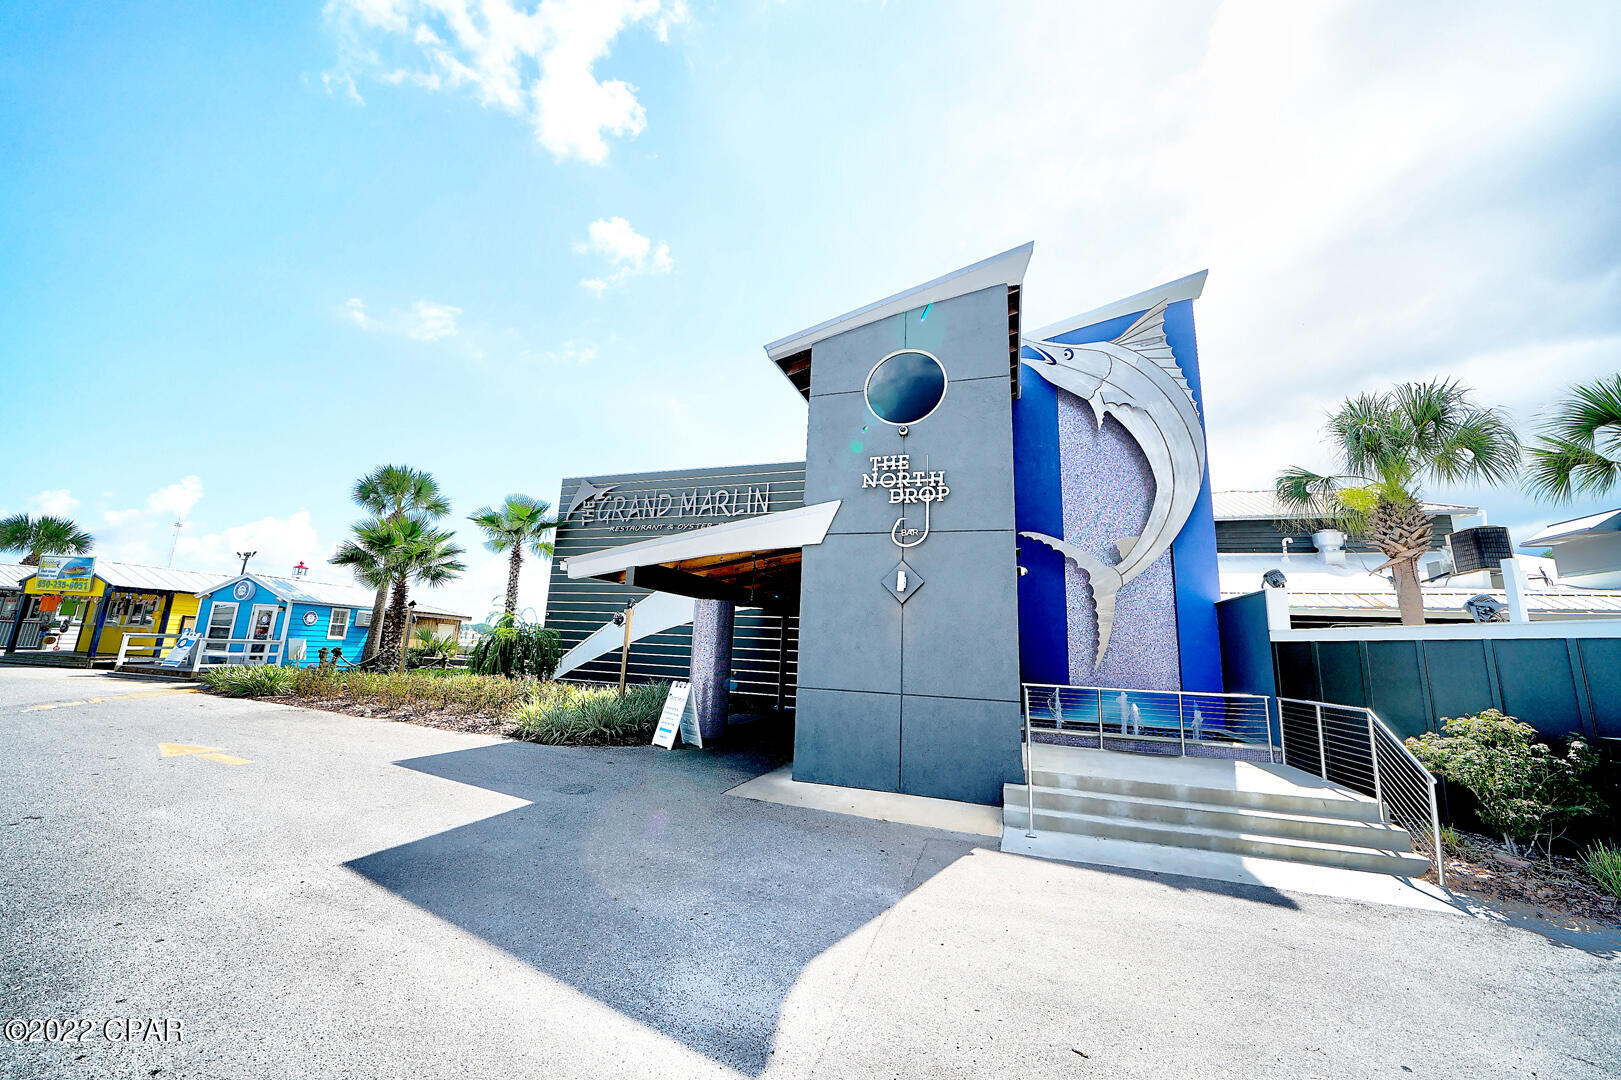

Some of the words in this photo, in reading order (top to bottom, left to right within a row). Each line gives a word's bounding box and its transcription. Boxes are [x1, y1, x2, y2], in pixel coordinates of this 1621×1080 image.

[870, 454, 909, 471] THE
[862, 471, 945, 488] NORTH
[888, 486, 950, 504] DROP
[581, 500, 596, 526] THE
[597, 489, 672, 524] GRAND
[679, 482, 770, 518] MARLIN
[609, 523, 666, 532] RESTAURANT
[678, 522, 713, 530] OYSTER
[901, 528, 919, 537] BAR
